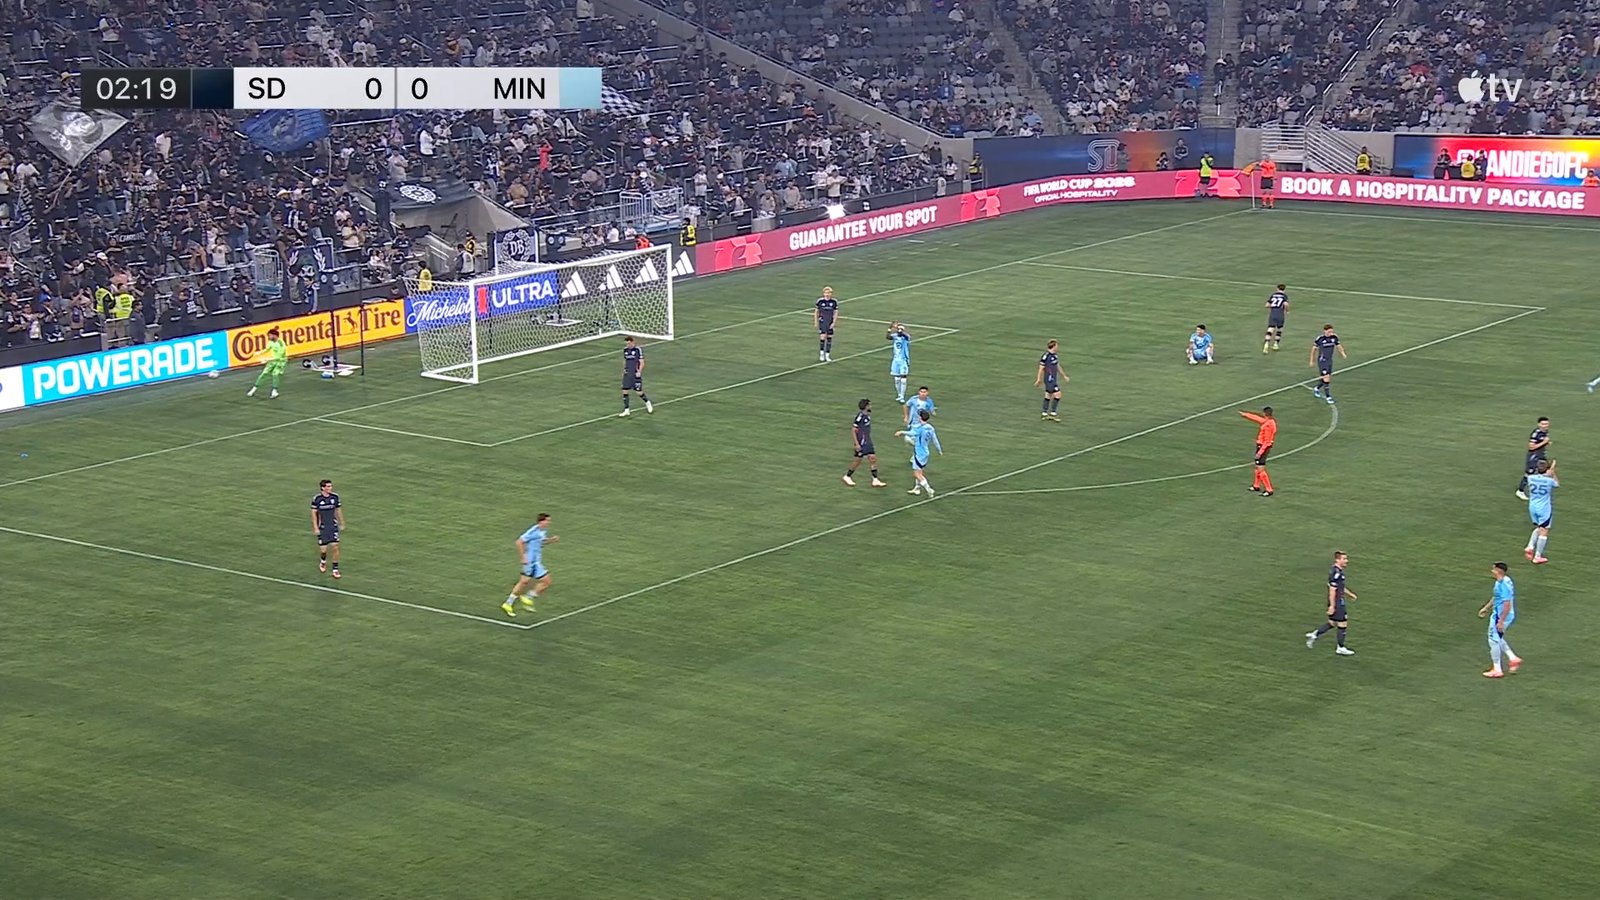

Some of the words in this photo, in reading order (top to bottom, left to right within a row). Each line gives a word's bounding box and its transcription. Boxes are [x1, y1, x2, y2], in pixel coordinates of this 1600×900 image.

[1040, 179, 1068, 193] WORLD
[1069, 178, 1093, 190] CUP
[1060, 189, 1119, 199] HOSPITALITY
[1281, 177, 1334, 196] BOOK
[1337, 179, 1352, 196] A
[1356, 180, 1483, 204] HOSPITALITY
[1487, 187, 1585, 210] PACKAGE
[789, 219, 867, 250] GUARANTEE
[868, 213, 903, 235] YOUR
[905, 205, 938, 227] SPOT
[492, 280, 555, 308] ULTRA
[1270, 297, 1284, 308] 27
[232, 314, 341, 362] Connental
[358, 306, 401, 332] Tire
[32, 337, 215, 400] POWERADE
[1529, 483, 1548, 496] 25
